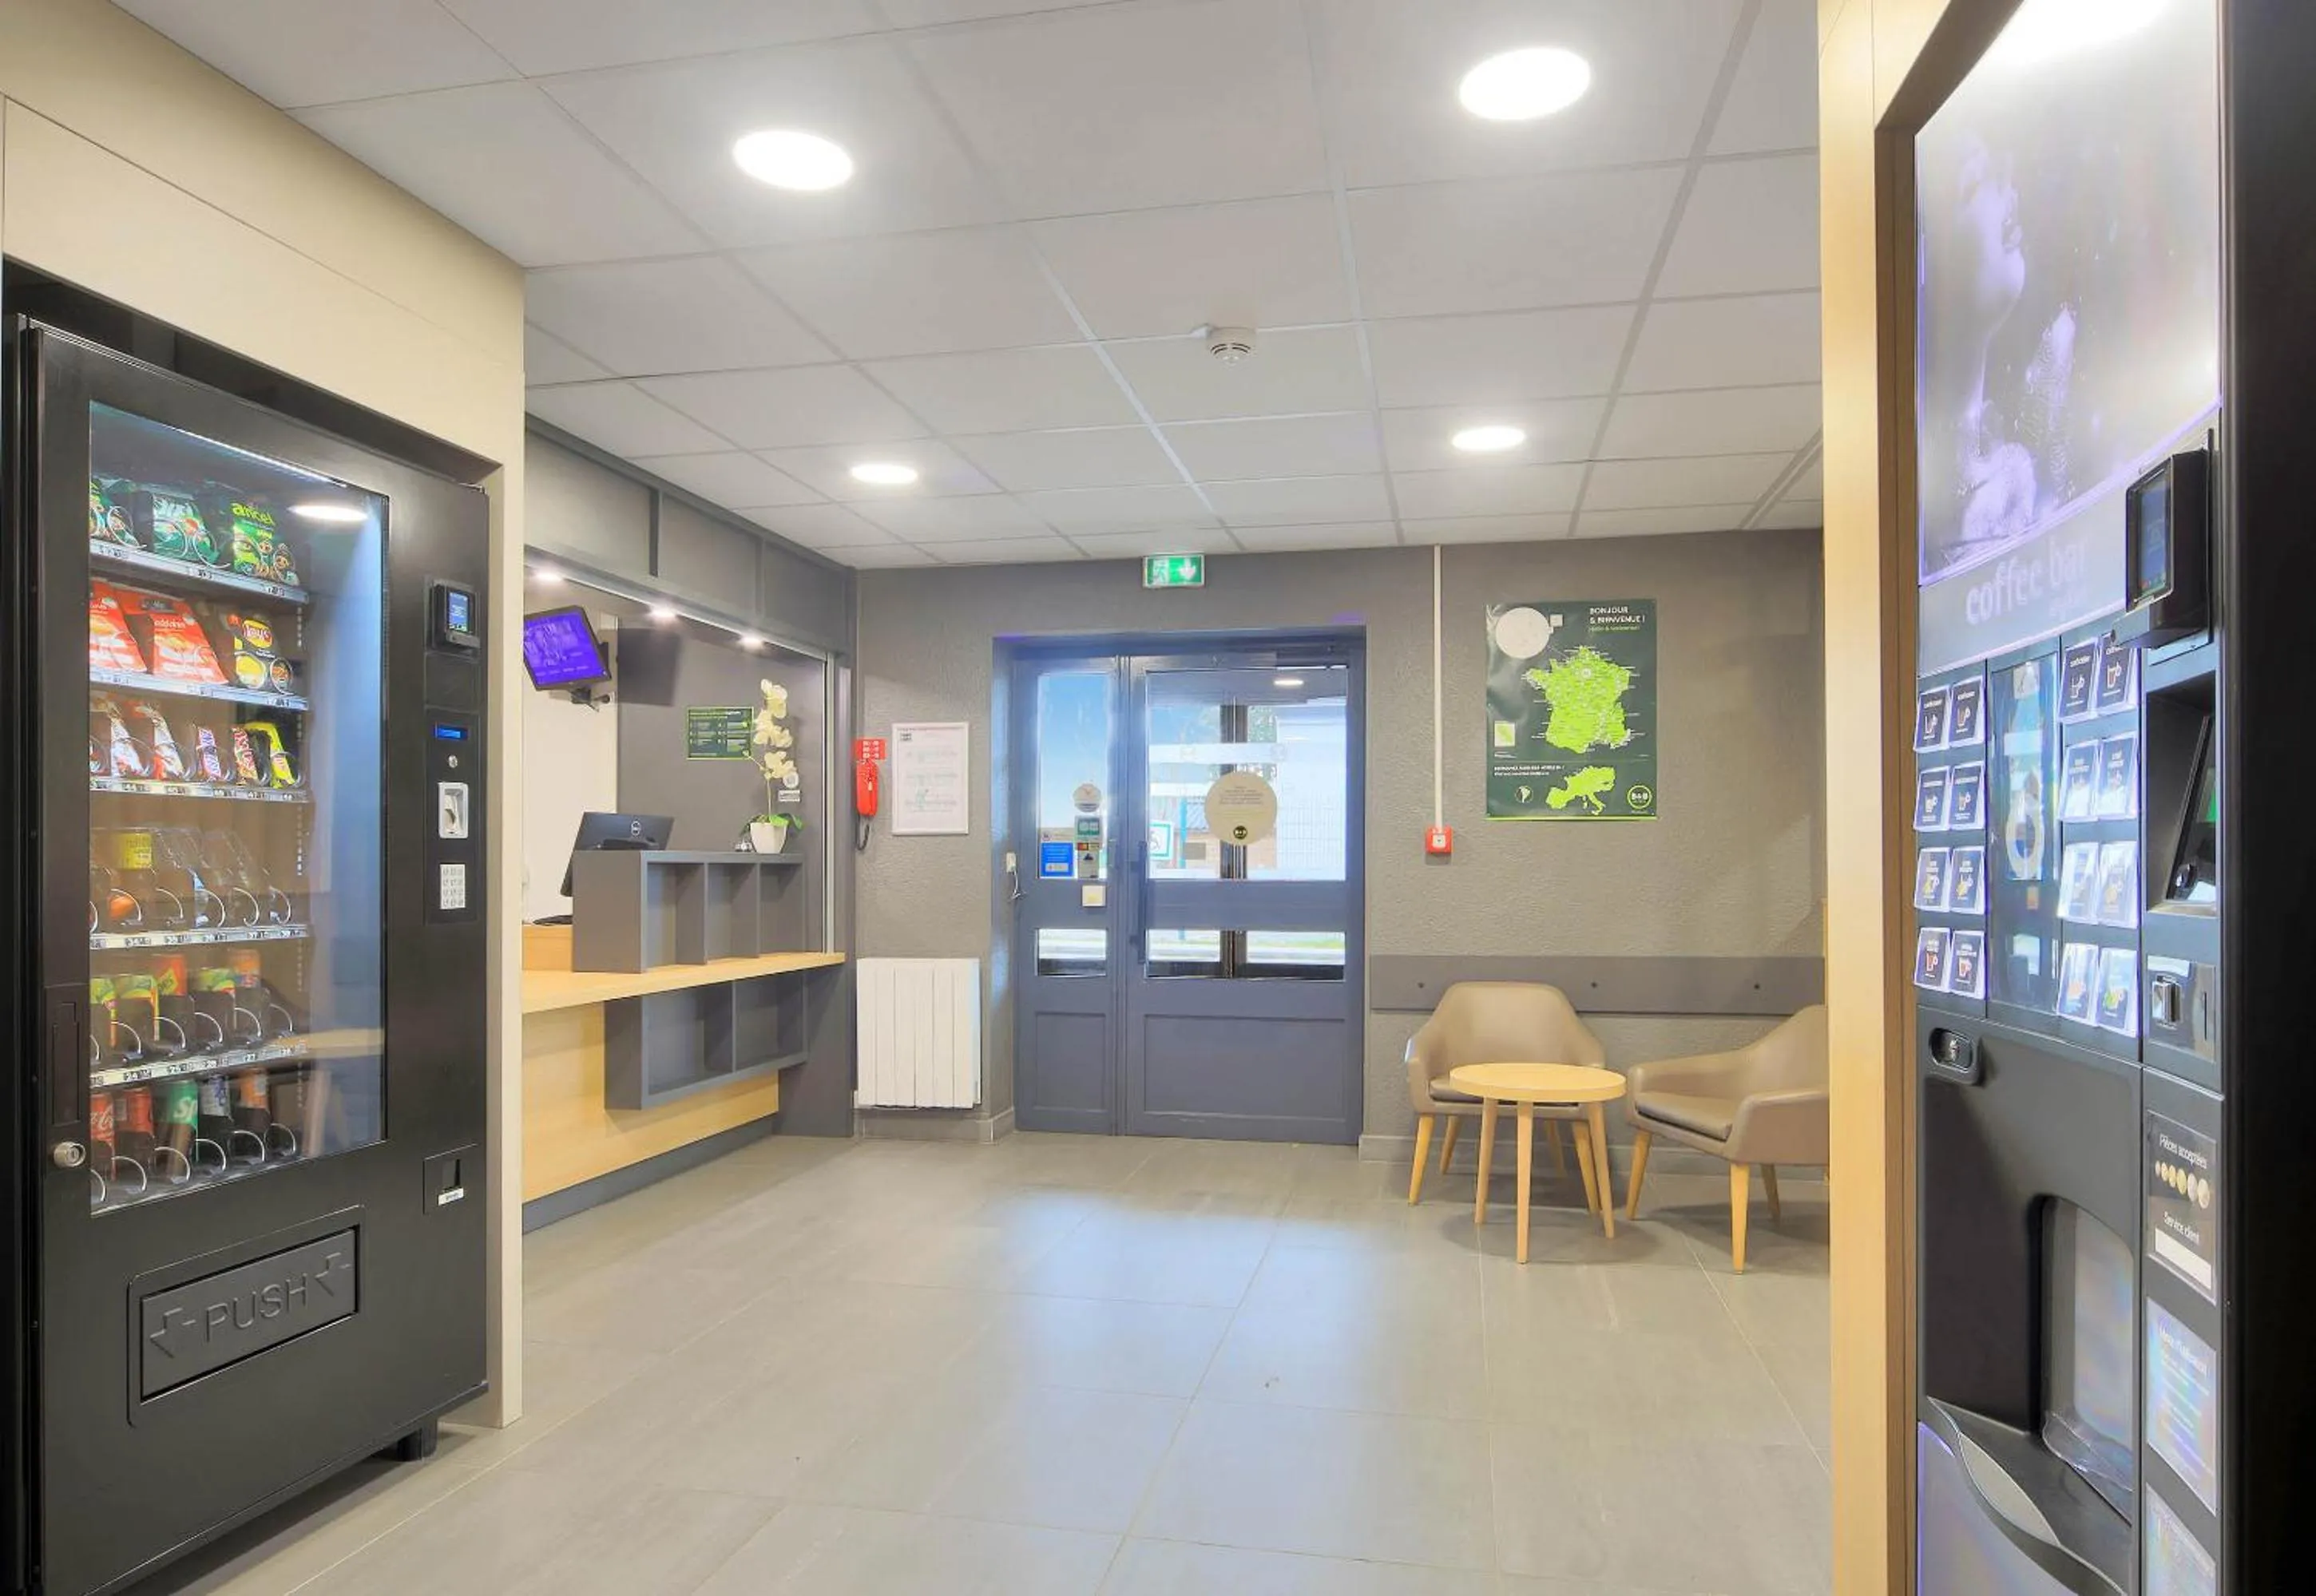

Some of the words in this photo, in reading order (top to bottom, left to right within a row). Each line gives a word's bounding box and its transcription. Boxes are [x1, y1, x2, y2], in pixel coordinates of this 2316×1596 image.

[1589, 606, 1628, 615] BONJOUR
[1966, 556, 2042, 624] coffee
[206, 1272, 307, 1343] PUSH
